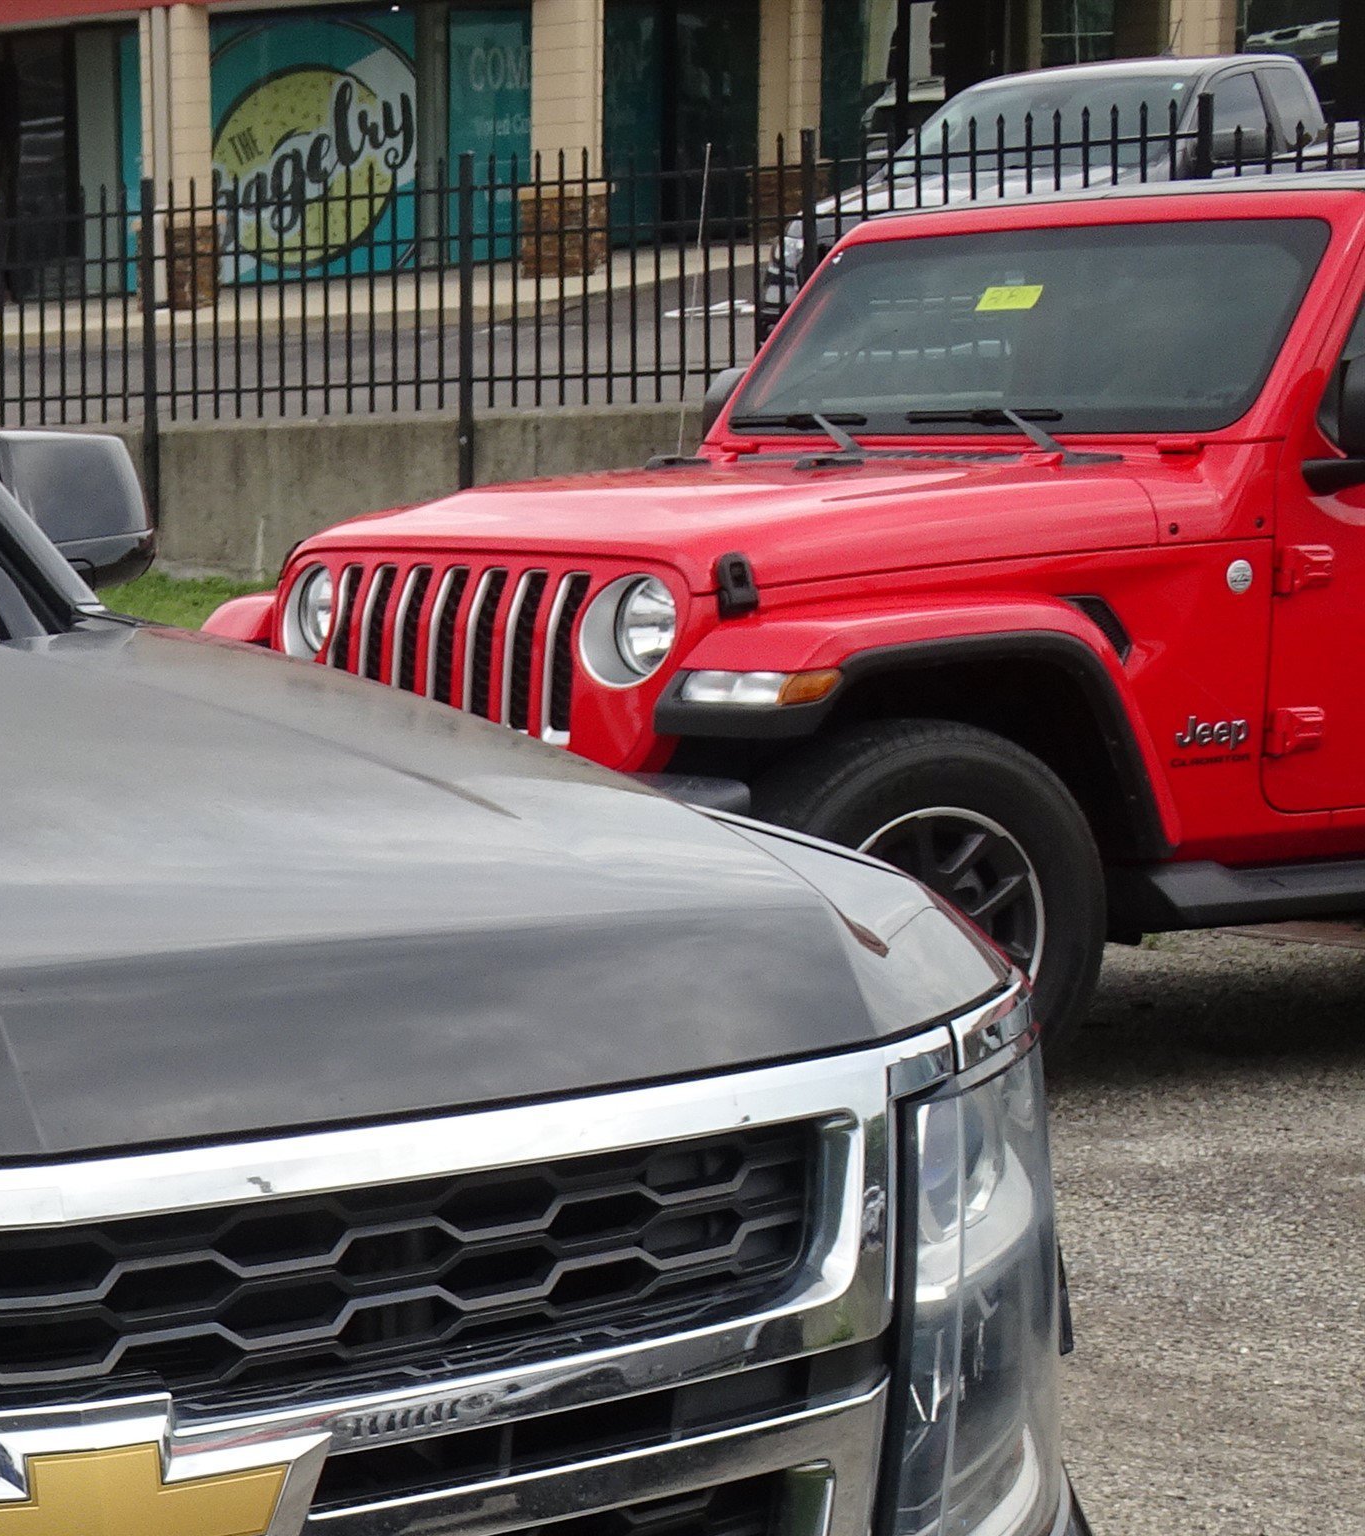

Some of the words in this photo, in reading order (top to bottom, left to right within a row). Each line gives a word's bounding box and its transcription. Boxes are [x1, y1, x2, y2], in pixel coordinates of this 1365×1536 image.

[470, 47, 531, 91] COM
[228, 126, 264, 166] THE
[1175, 715, 1249, 751] Jeep
